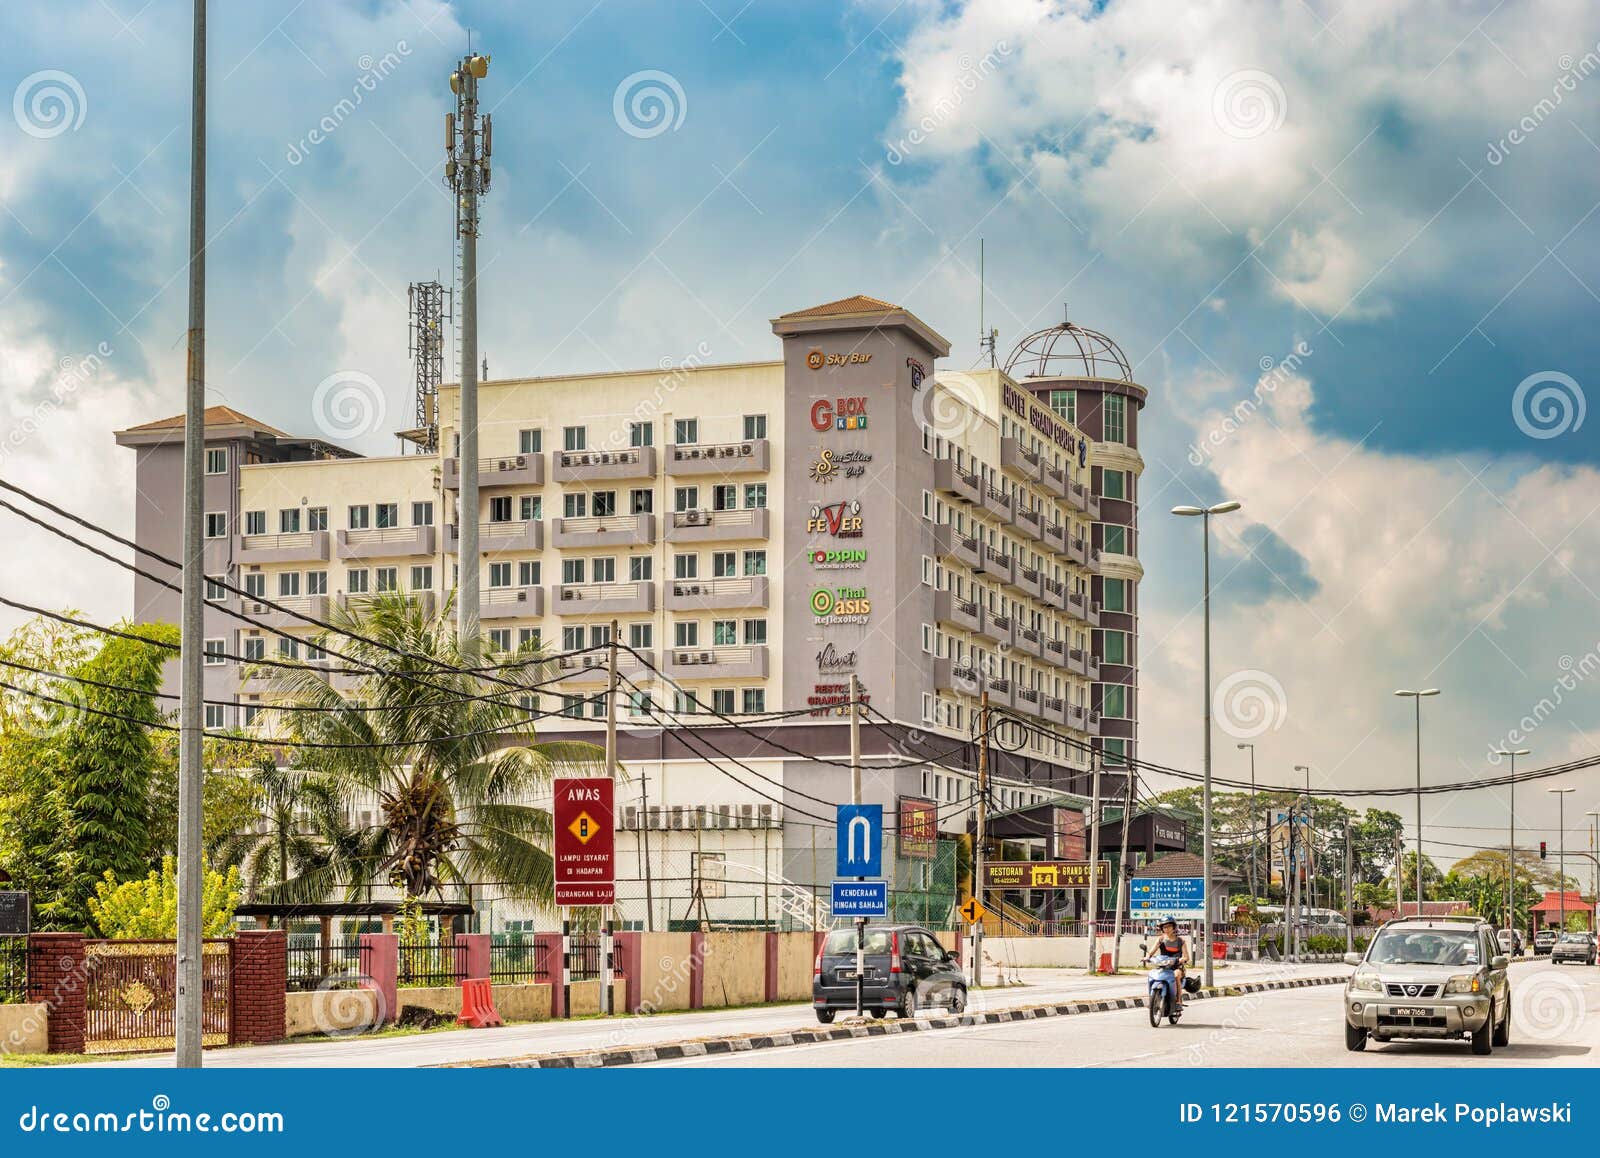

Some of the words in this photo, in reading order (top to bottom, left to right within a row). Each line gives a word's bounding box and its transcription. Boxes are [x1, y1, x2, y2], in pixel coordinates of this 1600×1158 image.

[827, 352, 848, 367] Sky
[850, 352, 872, 364] Bar
[810, 399, 833, 432] G
[836, 397, 868, 416] BOX
[1003, 383, 1027, 420] HOTEL
[1029, 404, 1054, 440] GRAND
[1053, 422, 1076, 456] COURT
[837, 416, 867, 430] KTV
[807, 501, 863, 536] FEVER
[837, 587, 866, 598] Thai
[814, 614, 869, 625] Reflexology
[567, 788, 600, 801] AWAS
[560, 854, 581, 862] LAMPU
[583, 854, 609, 862] ISYARAT
[576, 867, 603, 875] HADAPAN
[990, 866, 1024, 876] RESTORAN
[1062, 866, 1083, 876] GRAND
[597, 890, 614, 898] LAJU
[840, 889, 877, 897] KENDERAAN
[834, 901, 857, 909] RINGAN
[858, 901, 884, 909] SAHAJA
